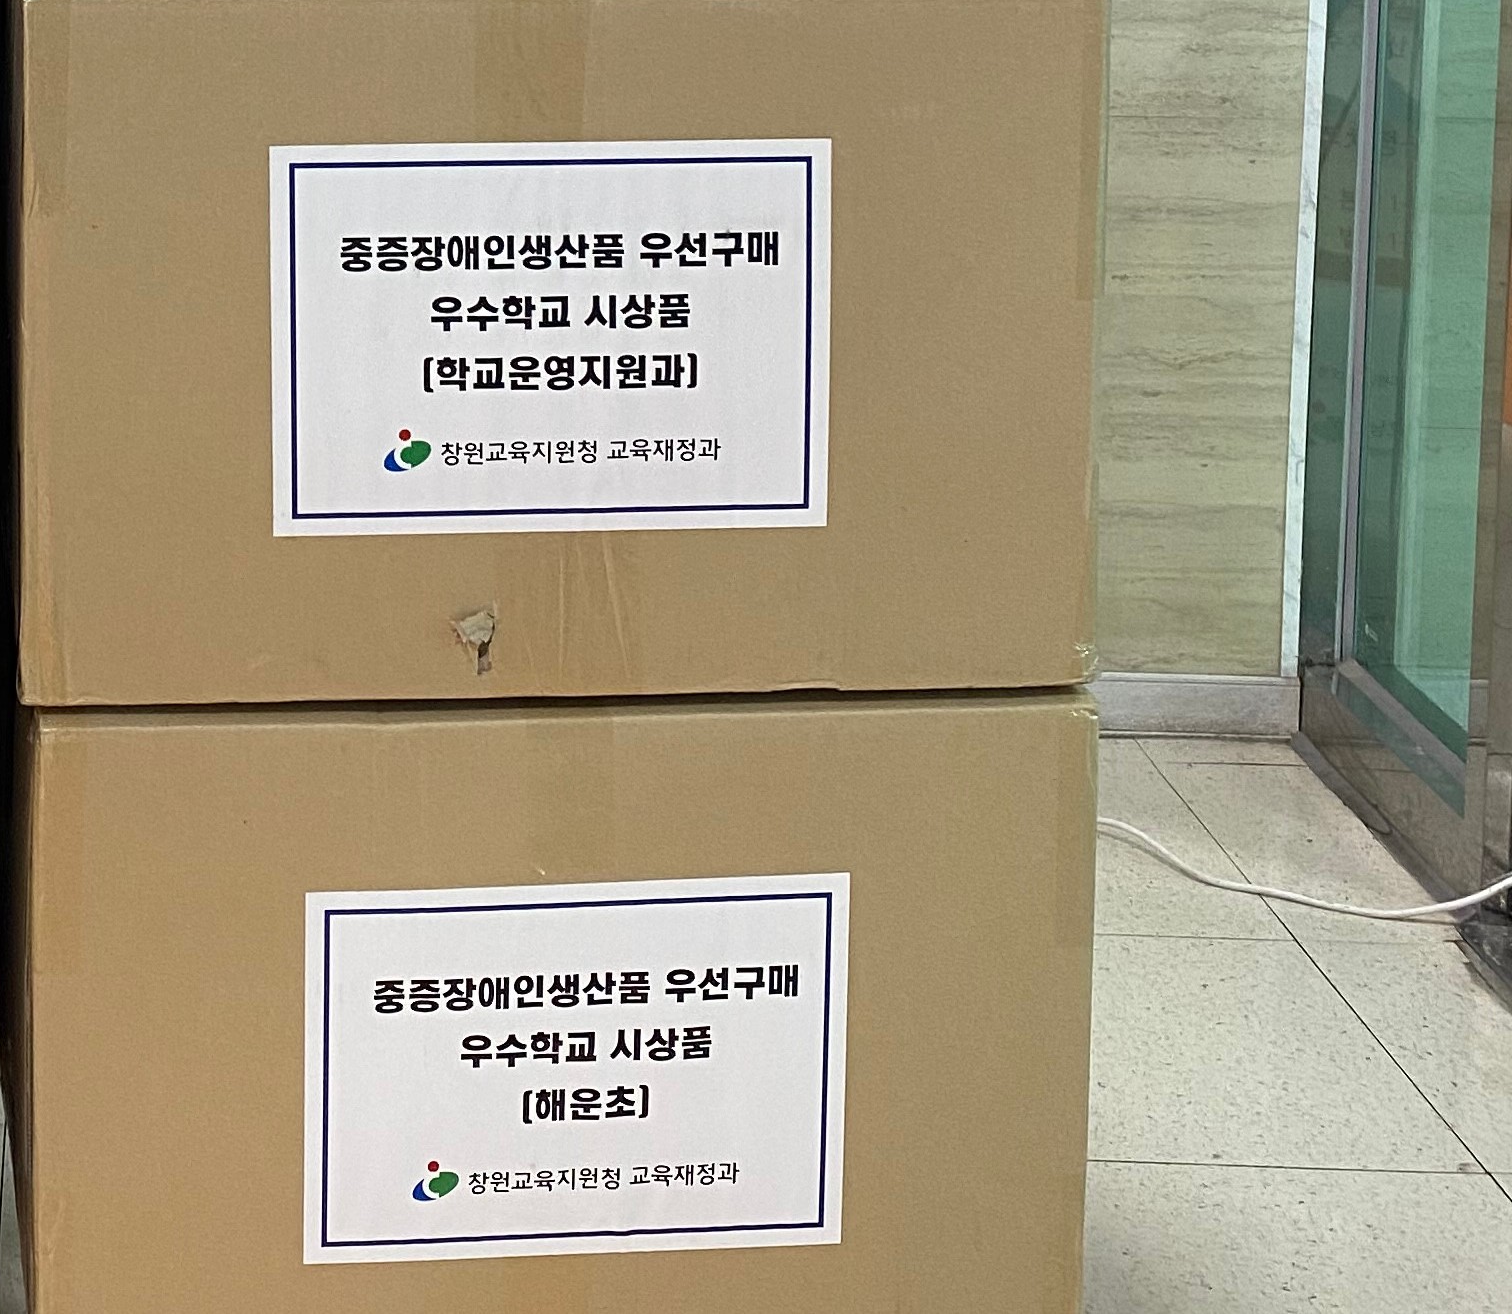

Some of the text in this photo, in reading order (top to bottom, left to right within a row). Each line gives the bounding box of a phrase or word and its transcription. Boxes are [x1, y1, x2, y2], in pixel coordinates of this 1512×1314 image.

[339, 230, 780, 274] 중증장애인생산품 우선구매
[429, 292, 692, 333] 우수학교 시상품
[440, 436, 723, 468] 창원교육지원청 교육재정과
[372, 963, 800, 1015] 중증장애인생산품 우선구매
[459, 1024, 714, 1070] 우수학교 시상품
[467, 1161, 741, 1196] 창원교육지원청 교육재정과
